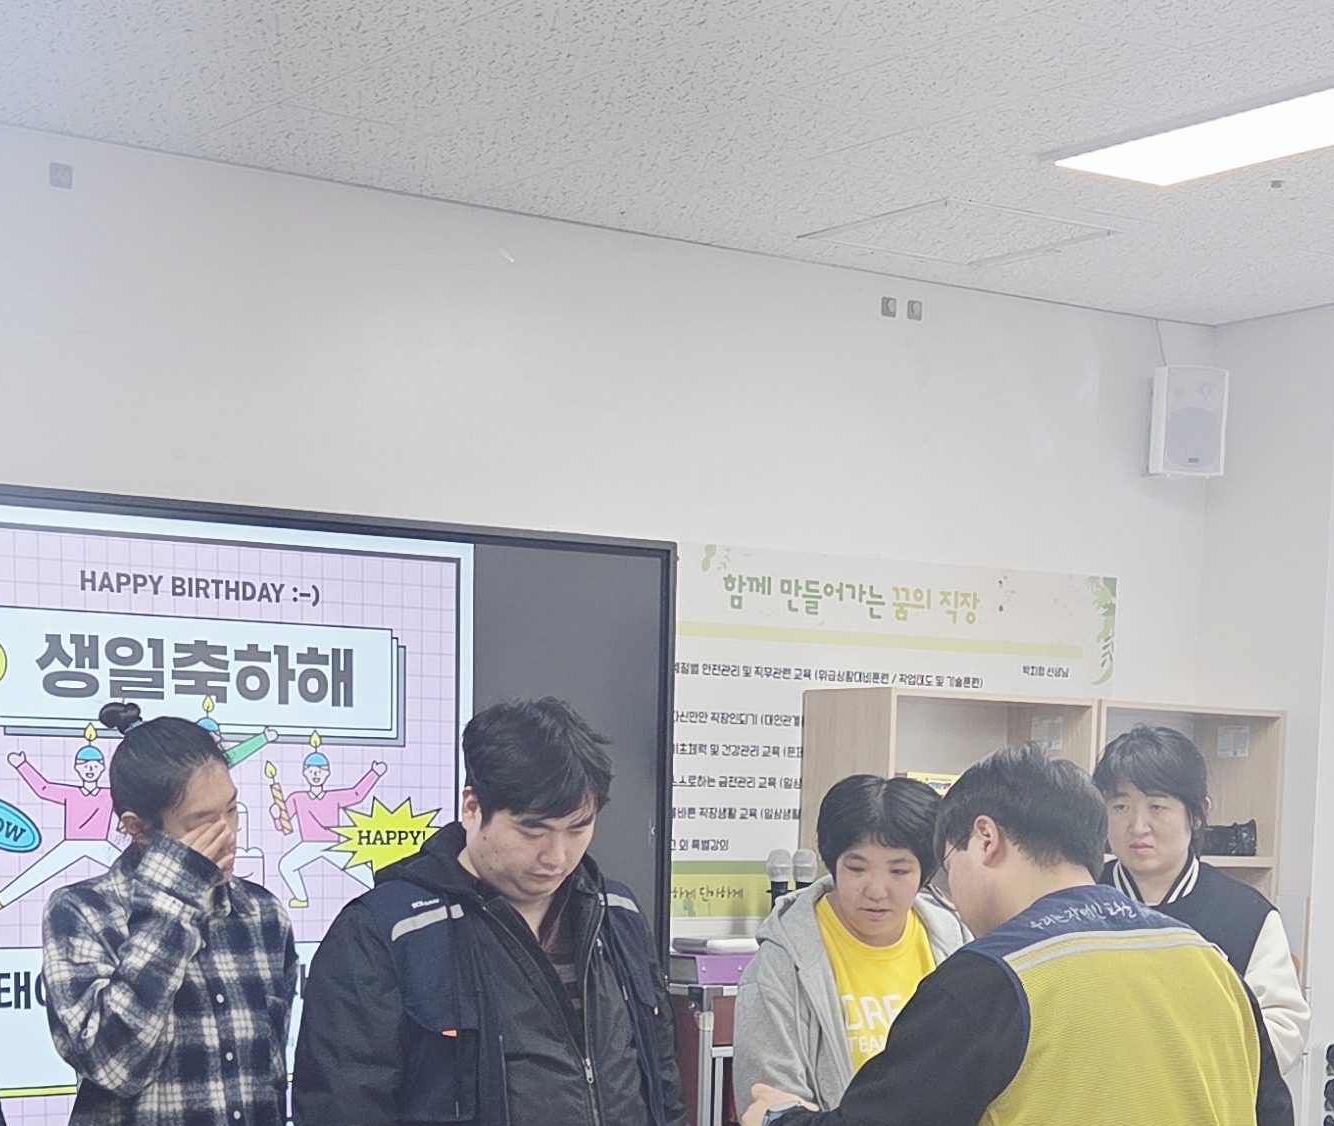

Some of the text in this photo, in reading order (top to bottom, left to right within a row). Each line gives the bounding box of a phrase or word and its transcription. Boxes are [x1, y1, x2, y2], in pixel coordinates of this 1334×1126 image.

[79, 570, 164, 596] HAPPY
[170, 575, 286, 604] BIRTHDAY
[722, 573, 981, 625] 함께 만들어가는 꿈의 직장
[35, 632, 354, 708] 생일축하해
[702, 662, 740, 677] 안전관리
[742, 665, 752, 678] 및
[754, 666, 792, 680] 직무관련
[793, 667, 812, 681] 교육
[935, 675, 945, 687] 및
[710, 712, 758, 725] 직장인되기
[709, 743, 720, 756] 및
[722, 744, 759, 757] 건강관리
[761, 745, 781, 758] 교육
[757, 776, 777, 789] 교육
[738, 807, 758, 820] 교육
